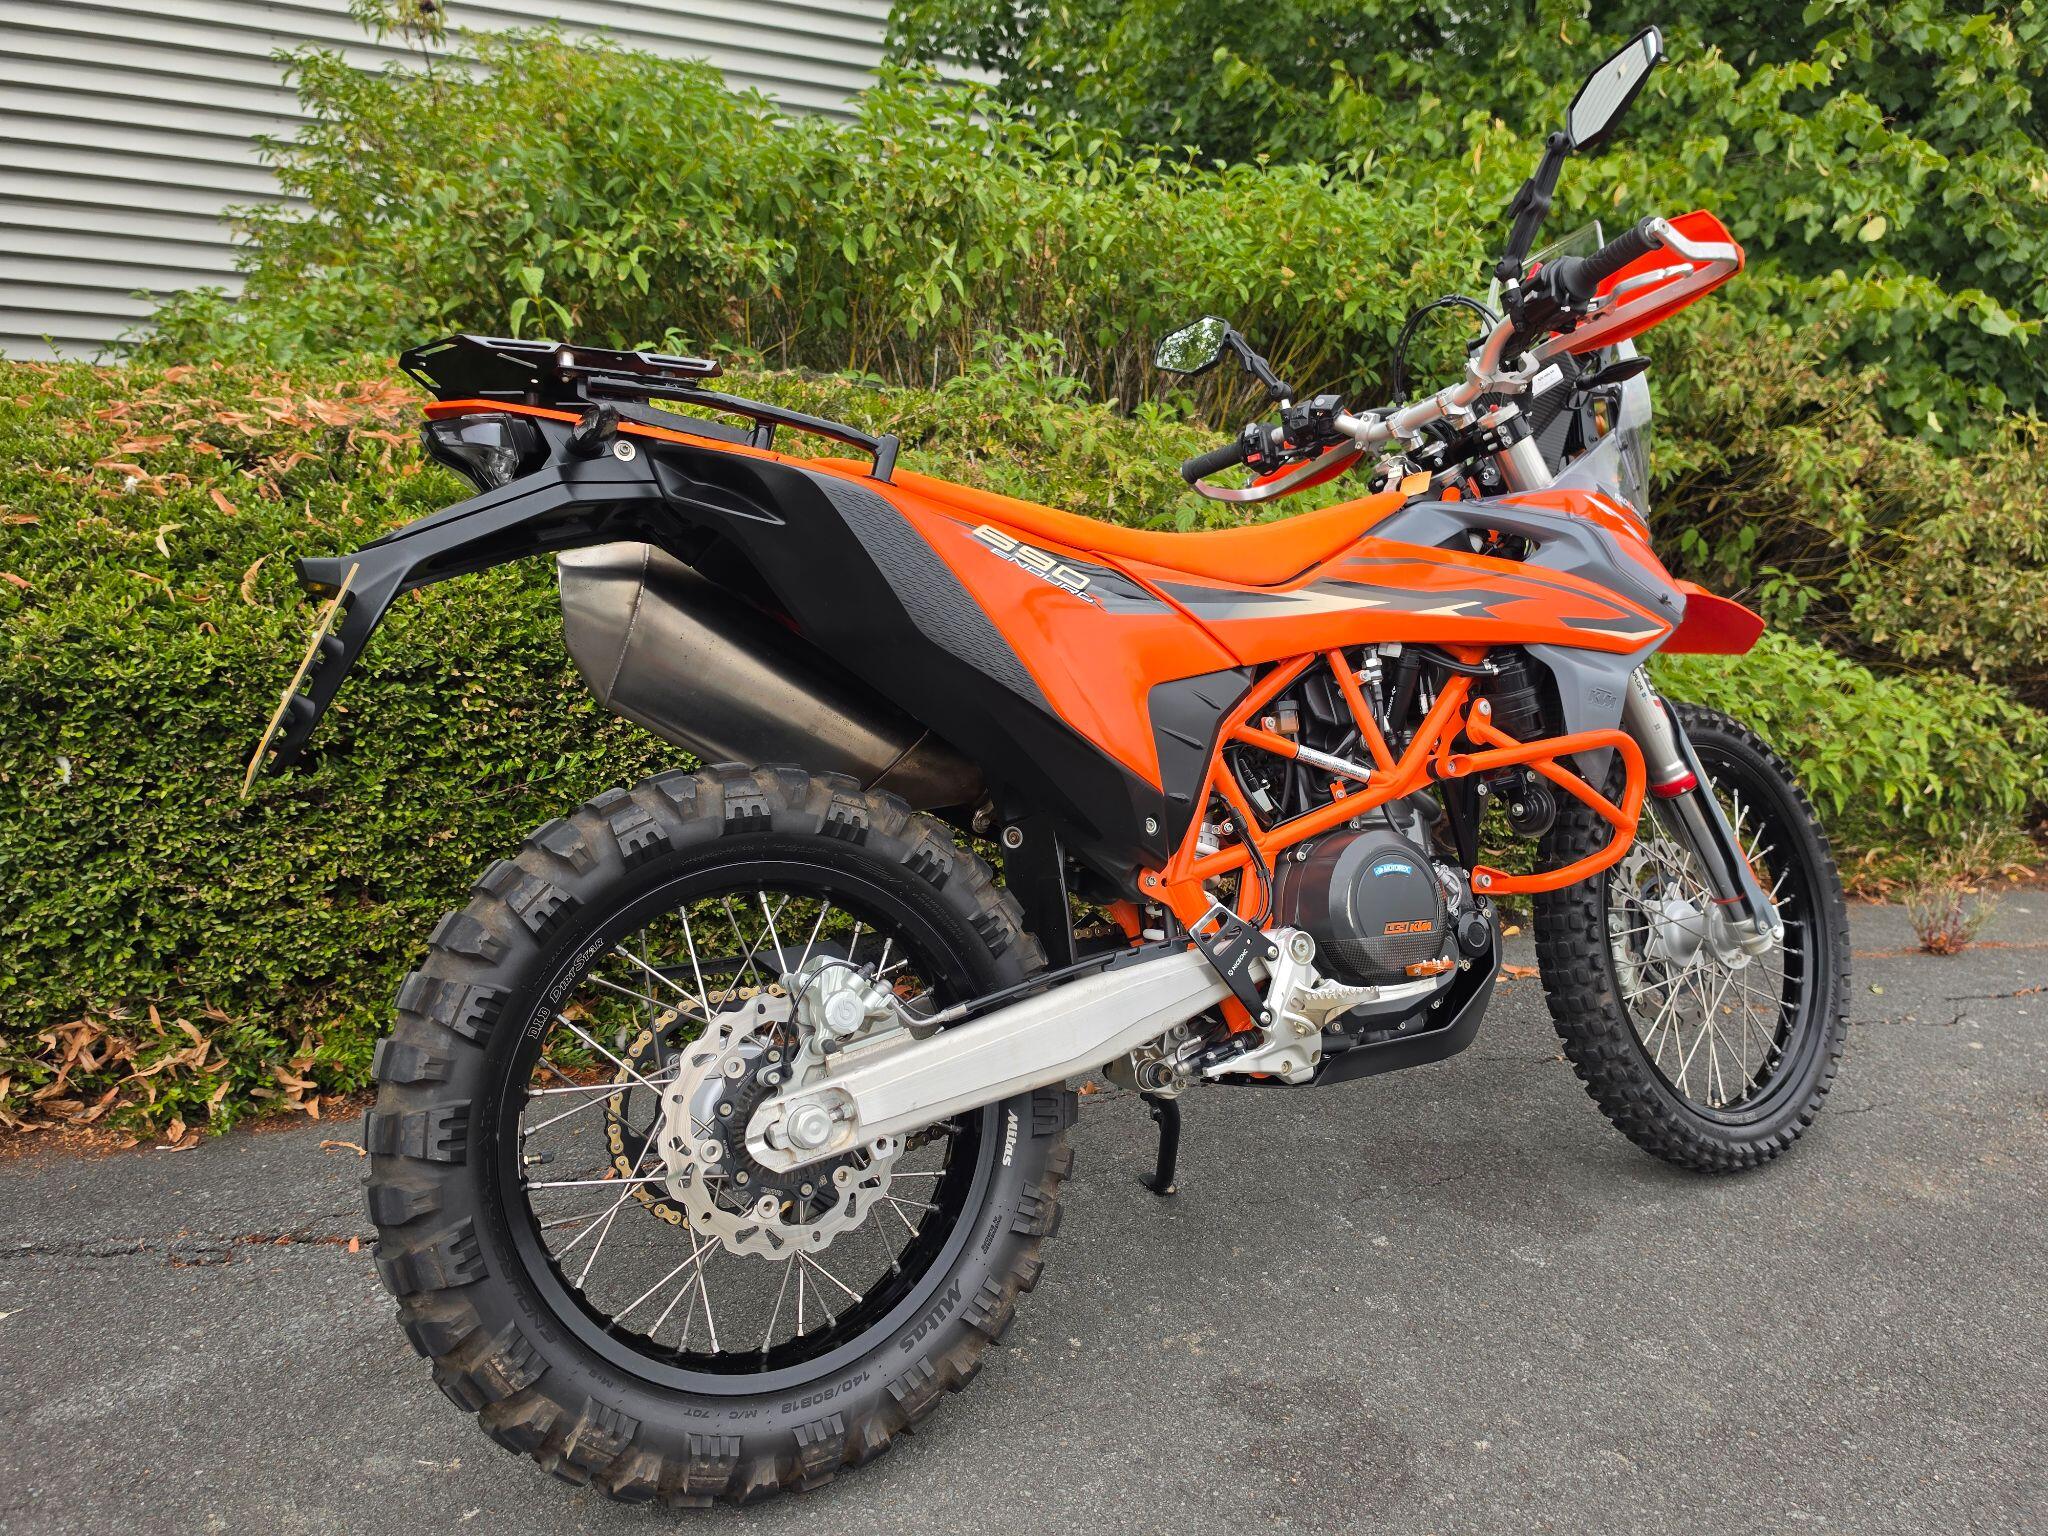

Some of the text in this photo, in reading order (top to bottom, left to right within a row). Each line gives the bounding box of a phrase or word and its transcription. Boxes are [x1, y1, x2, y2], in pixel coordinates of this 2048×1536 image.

[972, 524, 1091, 590] 690
[991, 548, 1095, 604] ENDURO
[1587, 688, 1617, 712] KTM
[1410, 920, 1432, 932] KTM
[1231, 948, 1249, 971] NICECNC
[1002, 1108, 1020, 1167] Mitas
[900, 1278, 962, 1353] Mitas
[684, 1408, 711, 1420] 70T
[728, 1409, 758, 1420] M/C
